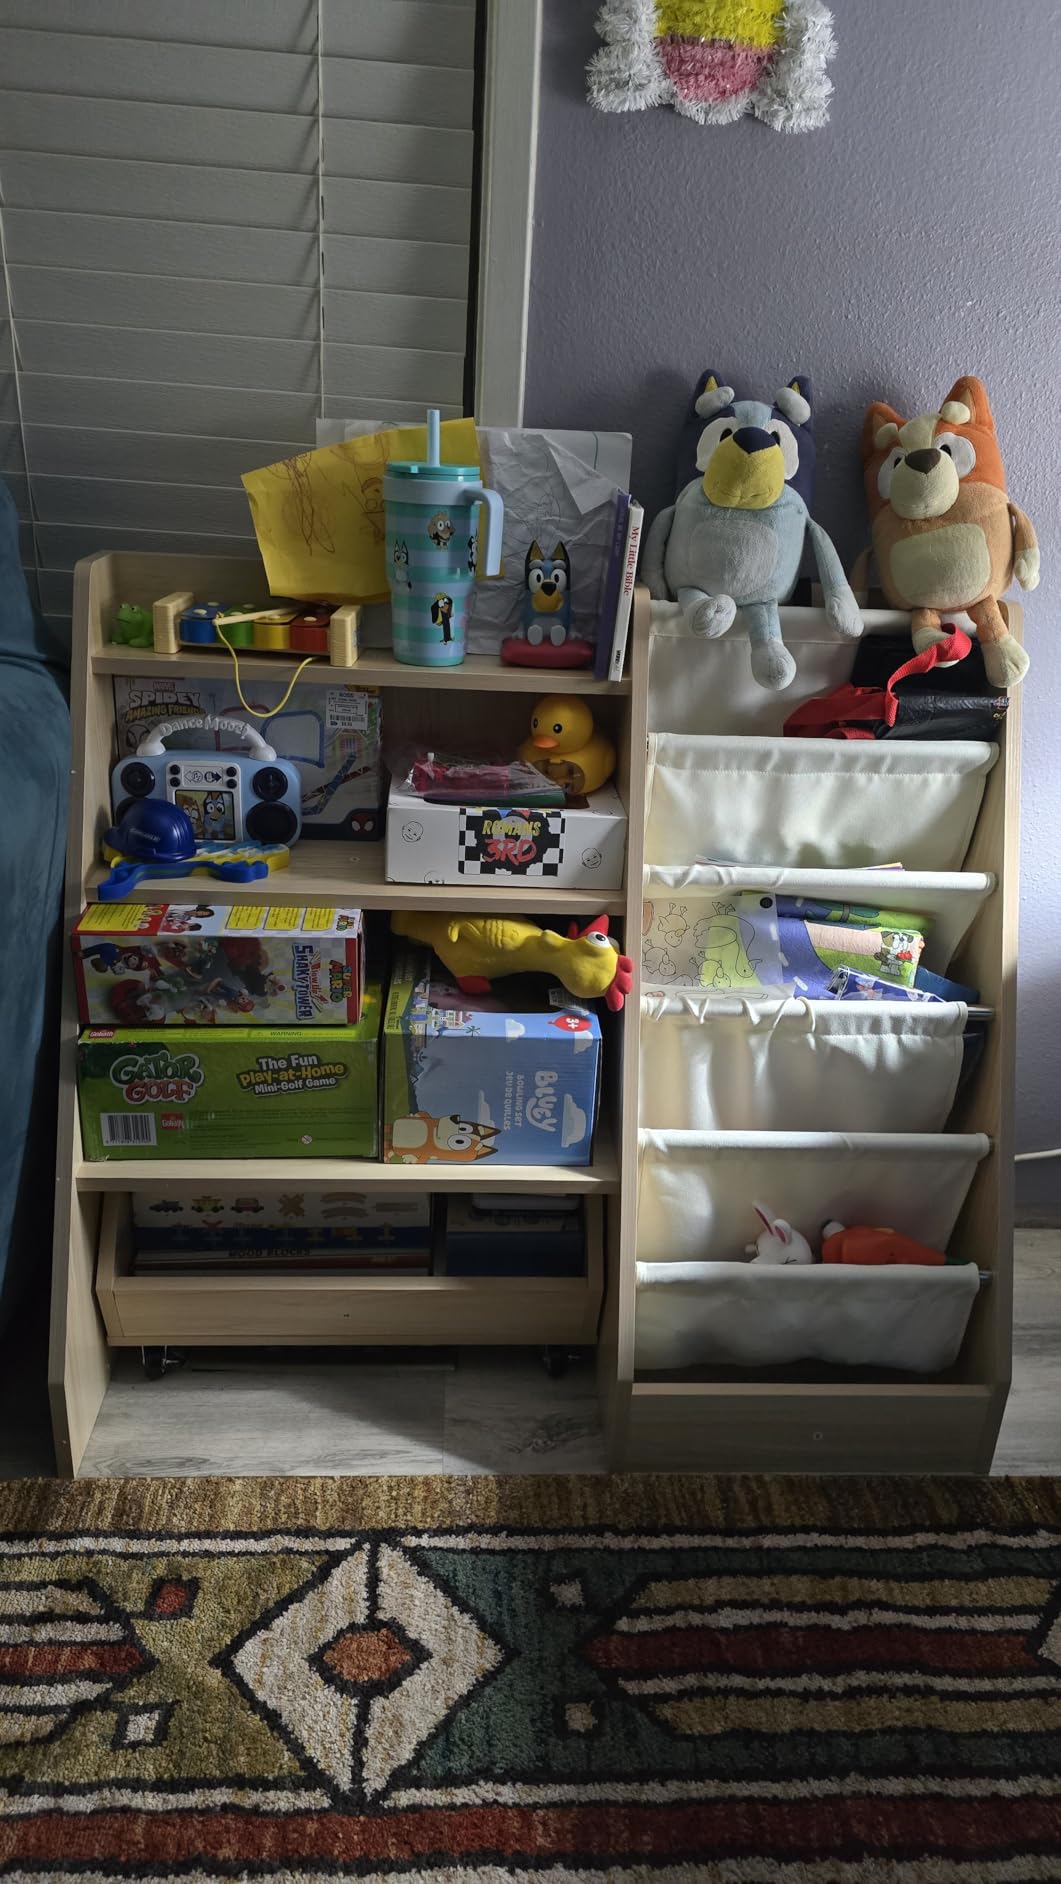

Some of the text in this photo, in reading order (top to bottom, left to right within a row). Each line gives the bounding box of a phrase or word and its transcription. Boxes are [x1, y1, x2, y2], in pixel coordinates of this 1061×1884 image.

[623, 526, 640, 596] My Little Bible
[129, 690, 201, 709] SPIDEY
[126, 704, 168, 724] AMAZING
[159, 718, 203, 737] Dance
[482, 838, 538, 866] 3RD
[293, 945, 314, 1017] SHAKY TOWER
[329, 959, 344, 1003] MARIO
[342, 965, 353, 999] SUPER
[565, 1017, 579, 1029] 3+
[111, 1051, 202, 1084] GATOR
[257, 1054, 318, 1071] The Fun
[239, 1063, 345, 1087] Play-at-Home
[254, 1076, 337, 1094] Mini-Golf Game
[125, 1080, 194, 1102] GOLF
